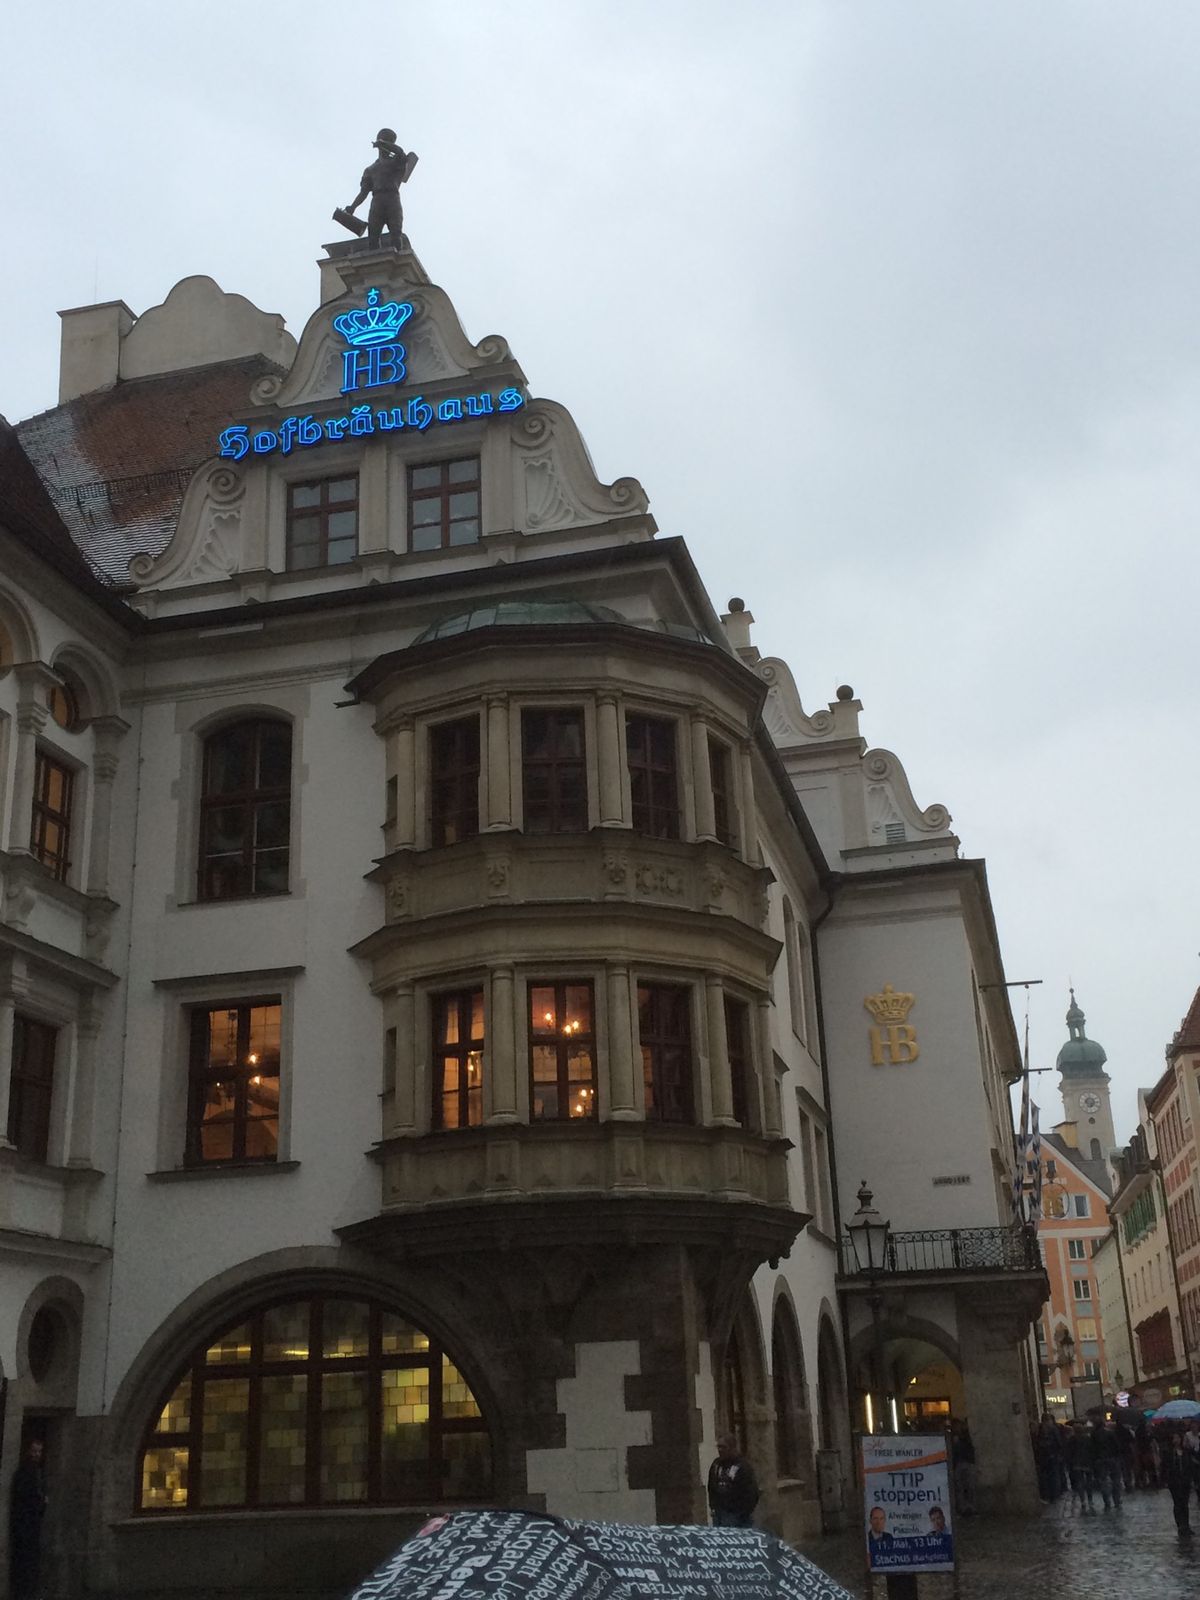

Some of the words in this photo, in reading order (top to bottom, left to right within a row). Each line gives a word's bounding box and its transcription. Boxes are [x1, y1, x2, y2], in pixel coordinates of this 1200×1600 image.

[341, 344, 406, 393] HB
[218, 388, 524, 460] Hofbräuhaus
[868, 1024, 920, 1066] HB
[888, 1472, 924, 1487] TTIP
[873, 1486, 941, 1505] stoppen!
[584, 1536, 661, 1555] SUISSE
[698, 1536, 768, 1548] Zermatt
[927, 1537, 943, 1546] Uhr
[484, 1521, 555, 1582] Lugano
[517, 1529, 571, 1578] Zermatt
[669, 1547, 769, 1561] Interlaken
[600, 1552, 680, 1568] Montreux
[697, 1560, 772, 1575] Lausanne
[875, 1554, 911, 1566] Stachus
[613, 1567, 660, 1582] Bern
